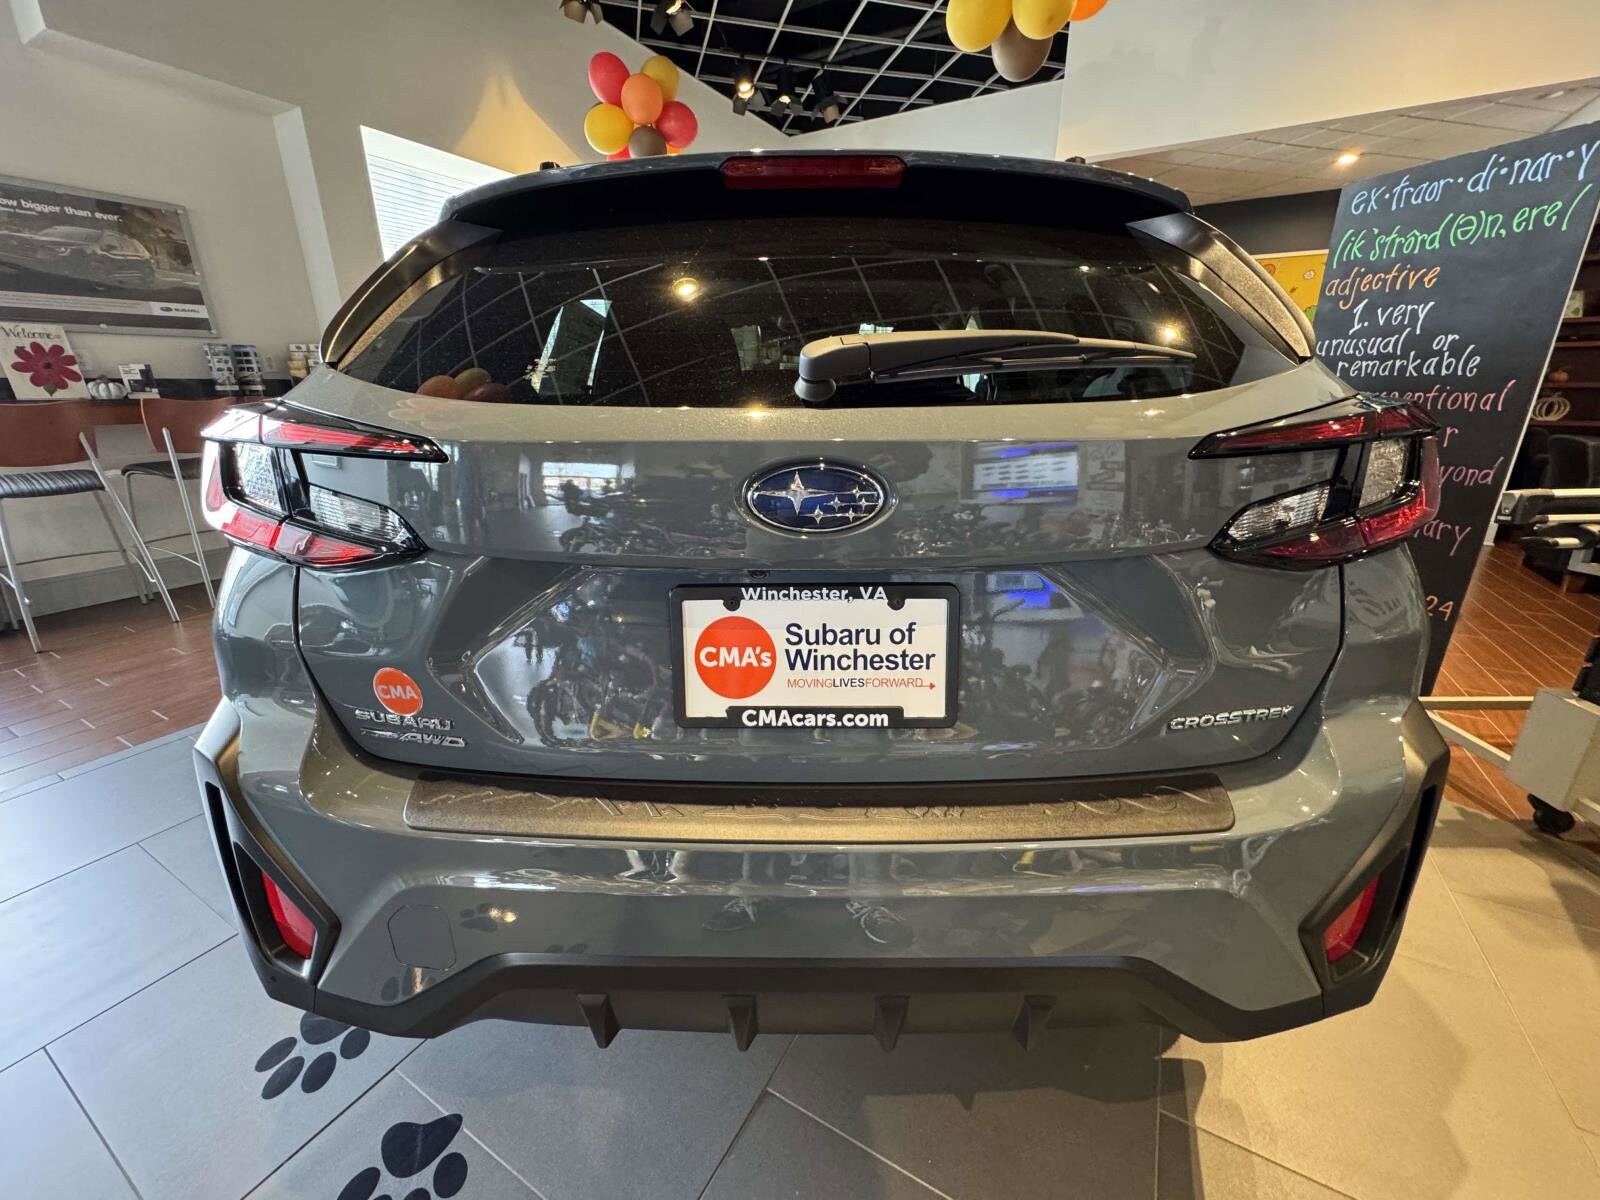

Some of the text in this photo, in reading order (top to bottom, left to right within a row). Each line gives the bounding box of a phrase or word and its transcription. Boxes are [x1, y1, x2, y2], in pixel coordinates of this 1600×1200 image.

[0, 198, 17, 207] ow
[20, 199, 61, 214] bigger
[64, 206, 92, 218] than
[94, 212, 123, 222] ever.
[1326, 263, 1440, 310] adjective
[1349, 299, 1435, 335] 1. very
[1, 325, 55, 340] Welcome
[1316, 327, 1460, 357] unusual or
[1336, 344, 1481, 377] remarkable
[1439, 456, 1504, 488] yond
[741, 586, 888, 603] Winchester, VA
[785, 622, 917, 646] Subaru of
[700, 646, 772, 668] CMA's
[785, 649, 936, 671] Winchester
[376, 685, 418, 699] CMA
[355, 709, 452, 730] SUBARU
[742, 710, 889, 727] CMAcars.com
[1170, 705, 1294, 729] CROSSTREK
